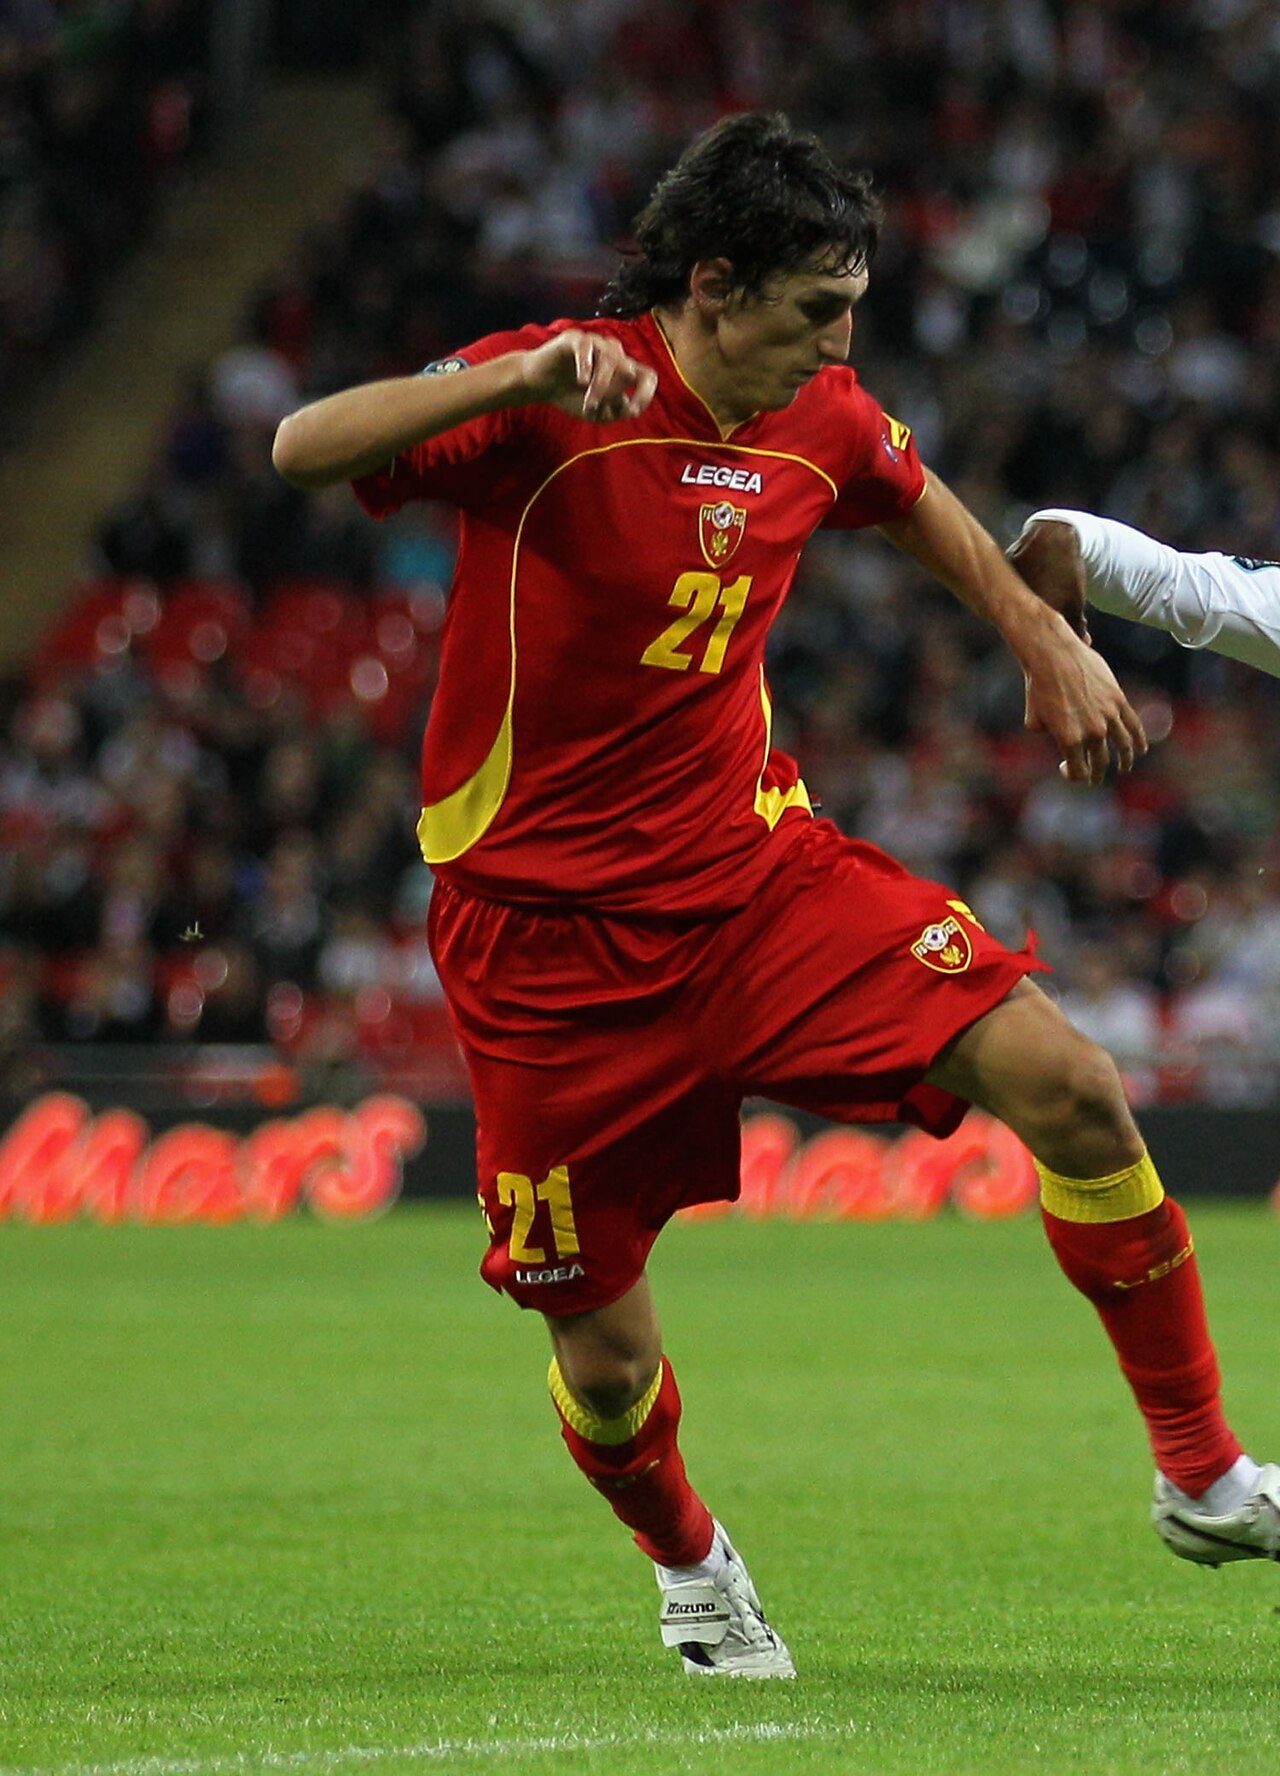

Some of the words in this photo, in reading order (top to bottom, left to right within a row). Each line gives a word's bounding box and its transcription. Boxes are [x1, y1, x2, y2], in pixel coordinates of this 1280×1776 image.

[680, 463, 763, 494] LEGEA
[640, 571, 753, 675] 21
[496, 1165, 580, 1264] 21
[515, 1263, 585, 1285] LEGEA
